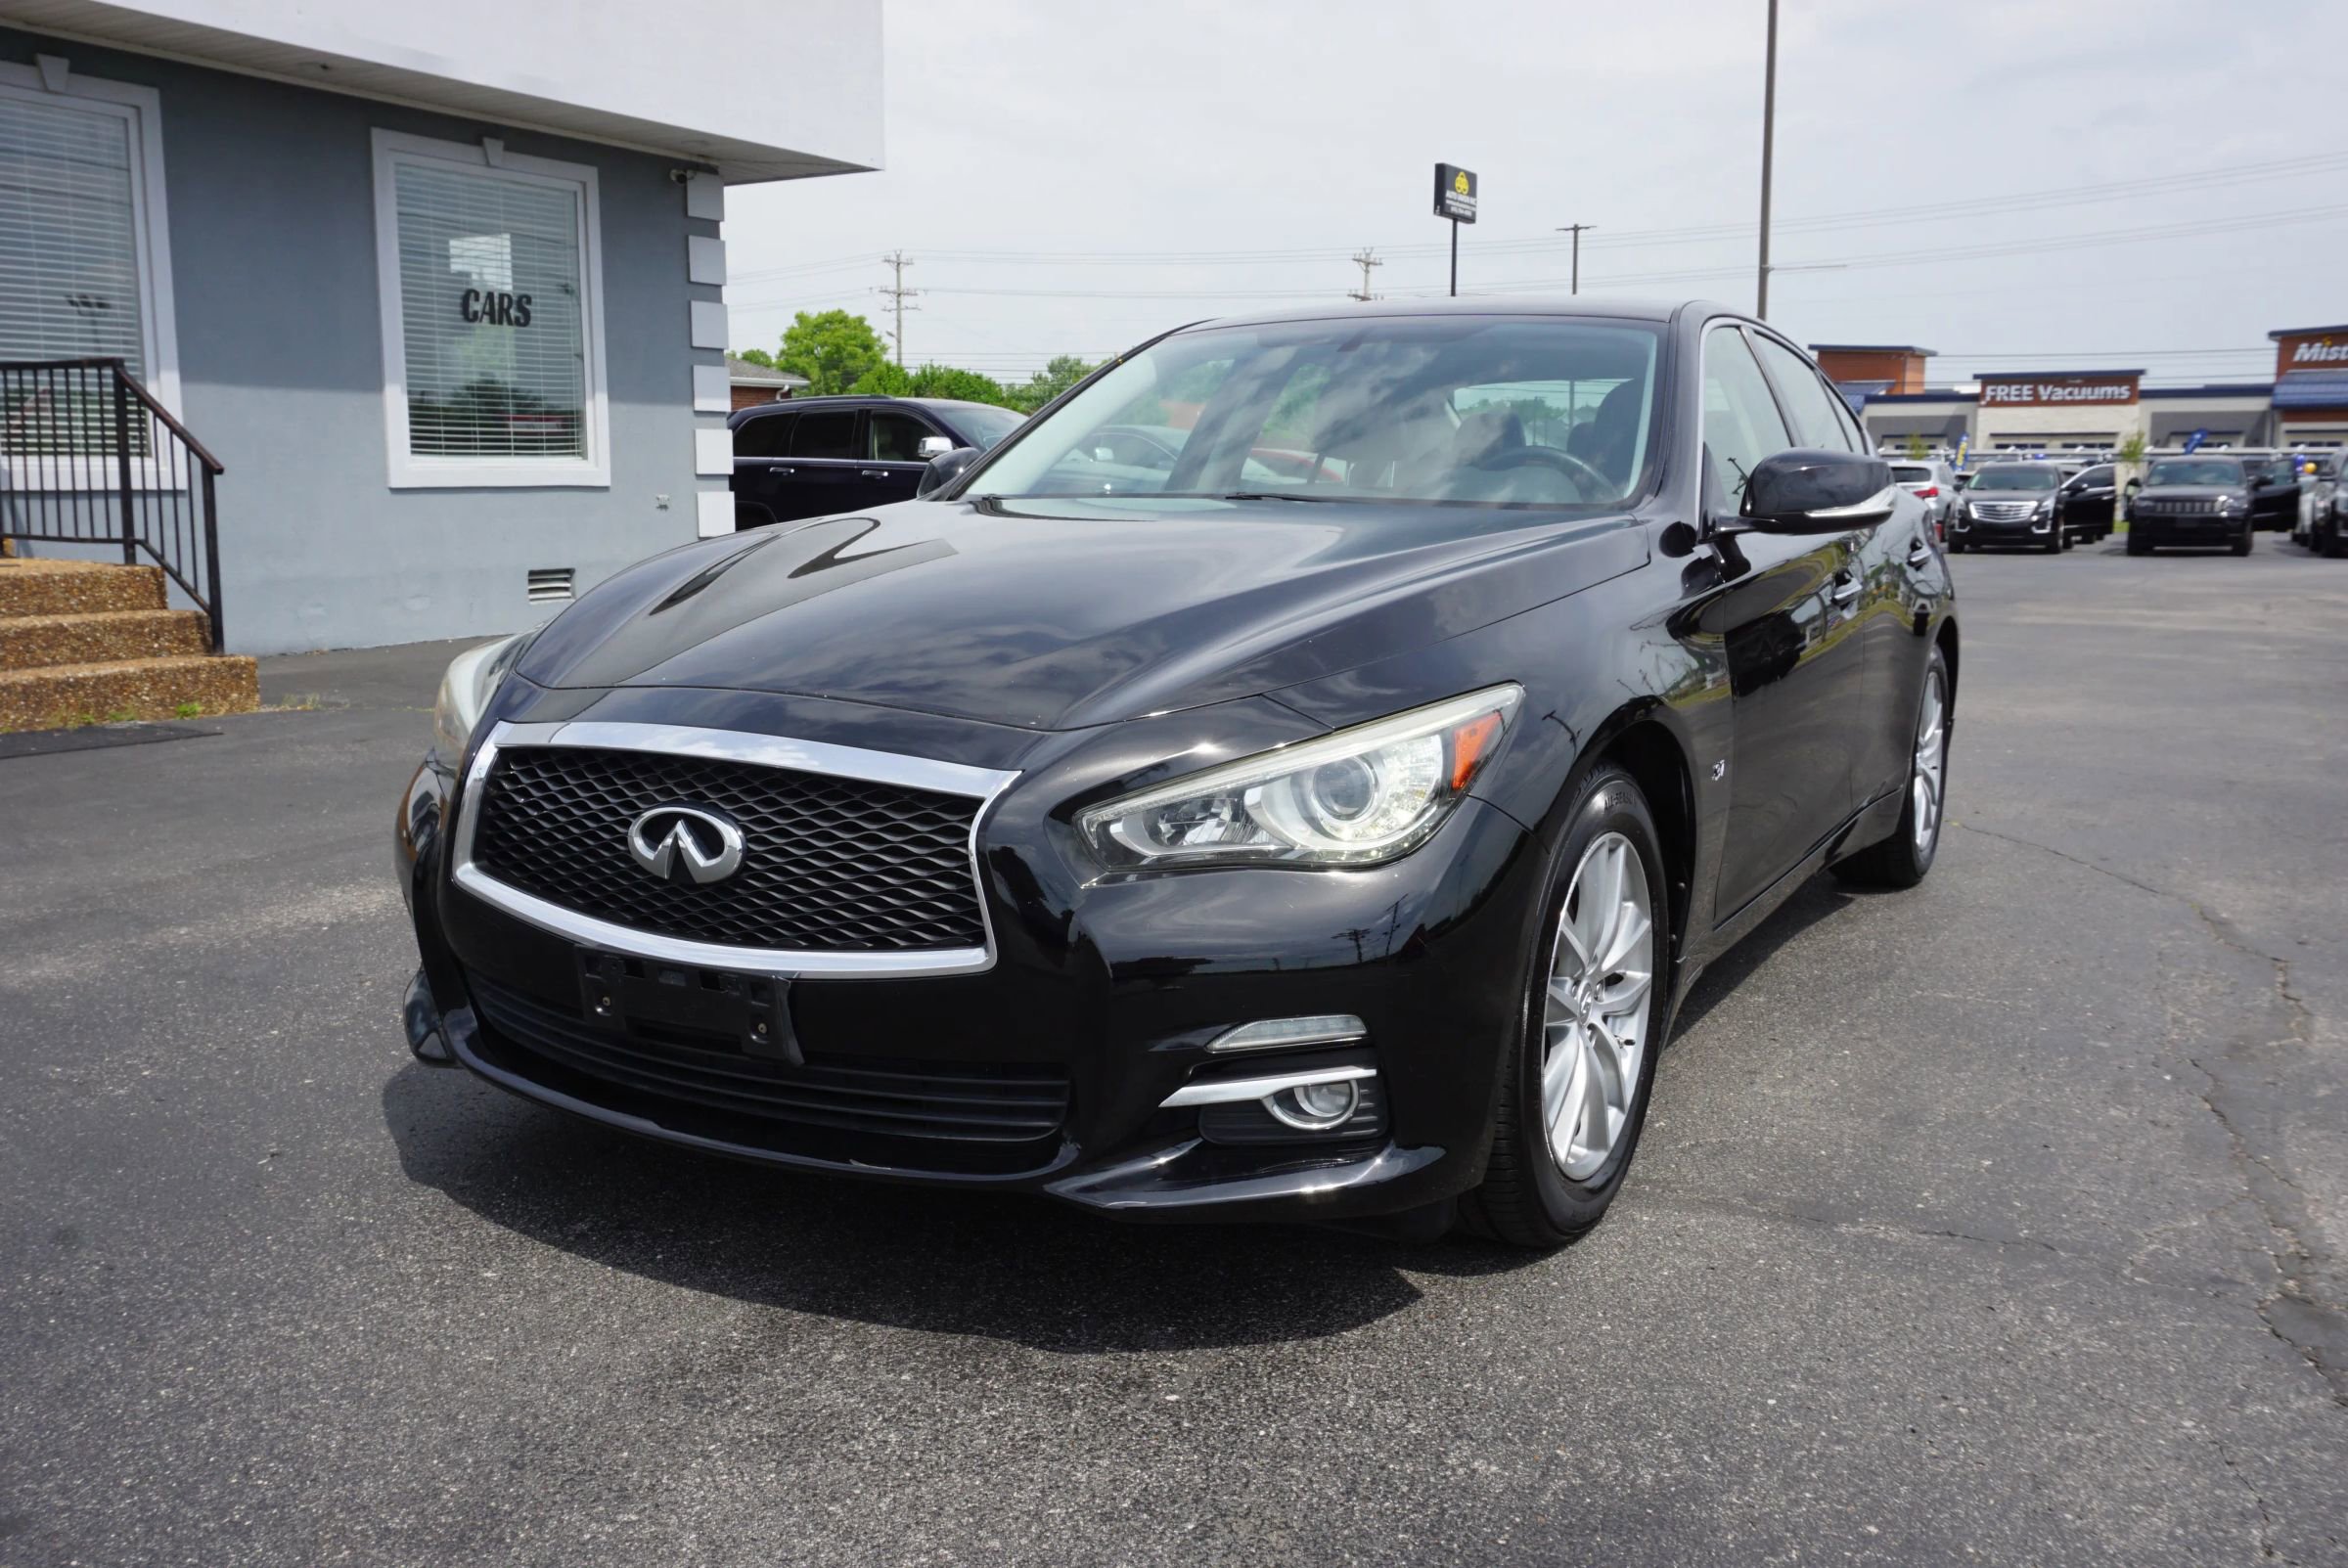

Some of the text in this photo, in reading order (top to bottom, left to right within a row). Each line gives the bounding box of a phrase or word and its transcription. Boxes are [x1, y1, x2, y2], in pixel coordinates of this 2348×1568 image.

[461, 289, 533, 328] CARS
[1985, 383, 2130, 402] FREE Vacuums
